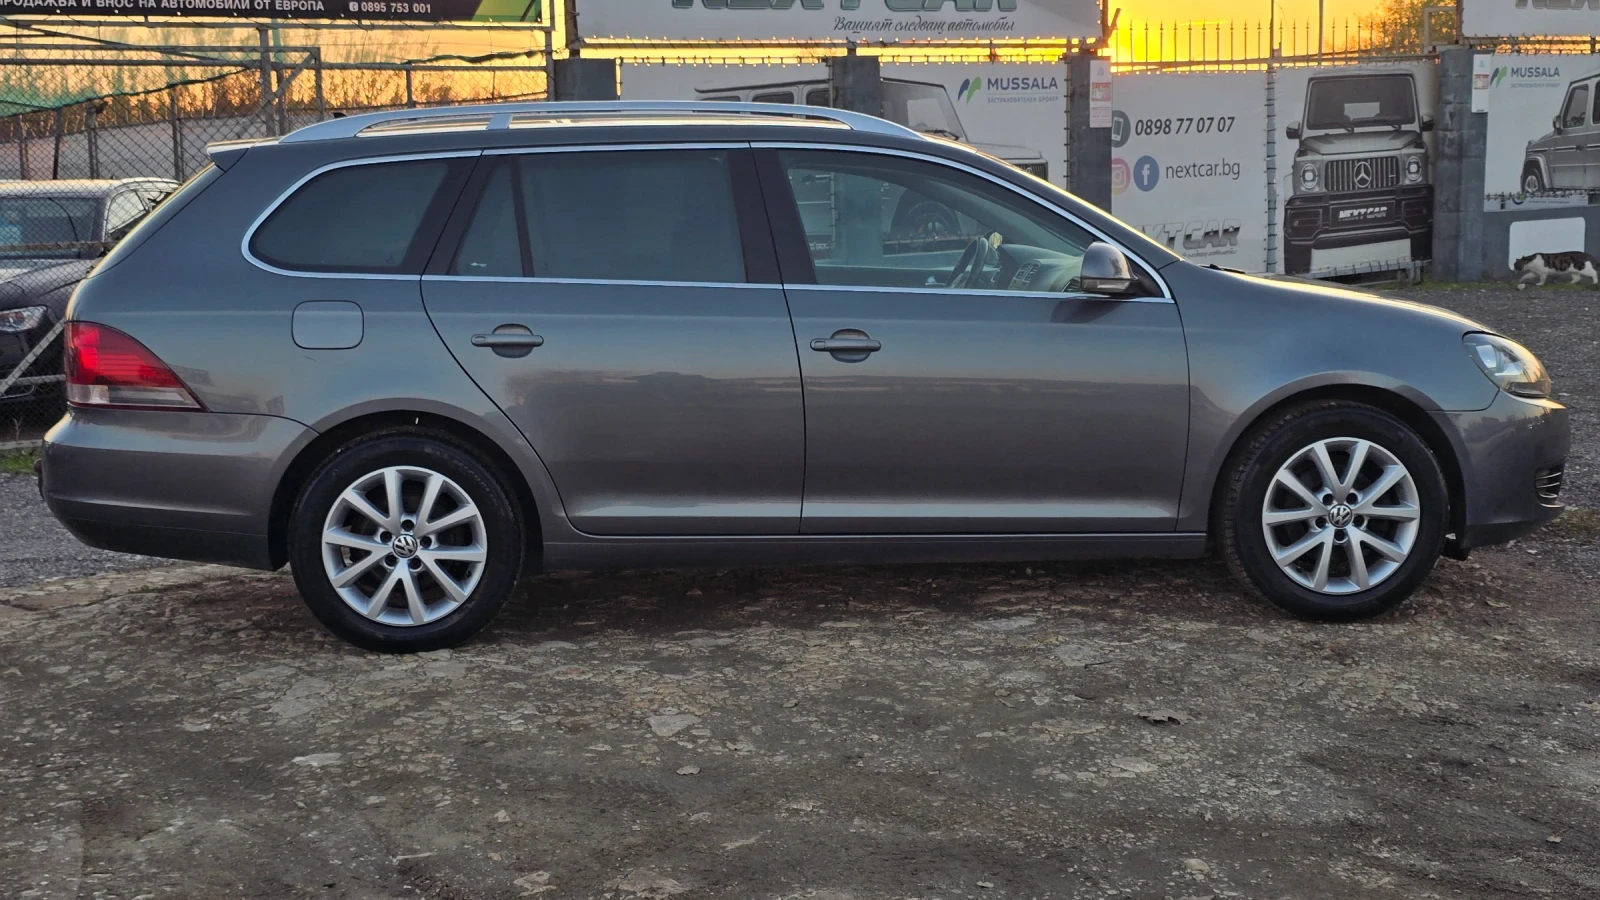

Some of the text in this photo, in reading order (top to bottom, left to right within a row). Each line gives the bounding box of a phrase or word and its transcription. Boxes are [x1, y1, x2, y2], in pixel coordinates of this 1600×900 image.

[139, 0, 156, 8] НА
[161, 0, 250, 9] АВТОМОБИЛИ
[254, 0, 271, 10] ОТ
[275, 0, 325, 11] ЕВРОПА
[361, 2, 431, 13] 0895 753 001
[834, 15, 1016, 34] Вашият следващ автомобил
[1511, 66, 1560, 78] MUSSALA
[987, 77, 1058, 91] MUSSALA
[1135, 116, 1236, 136] 0898 77 07 07
[1165, 158, 1240, 180] nextcar.bg
